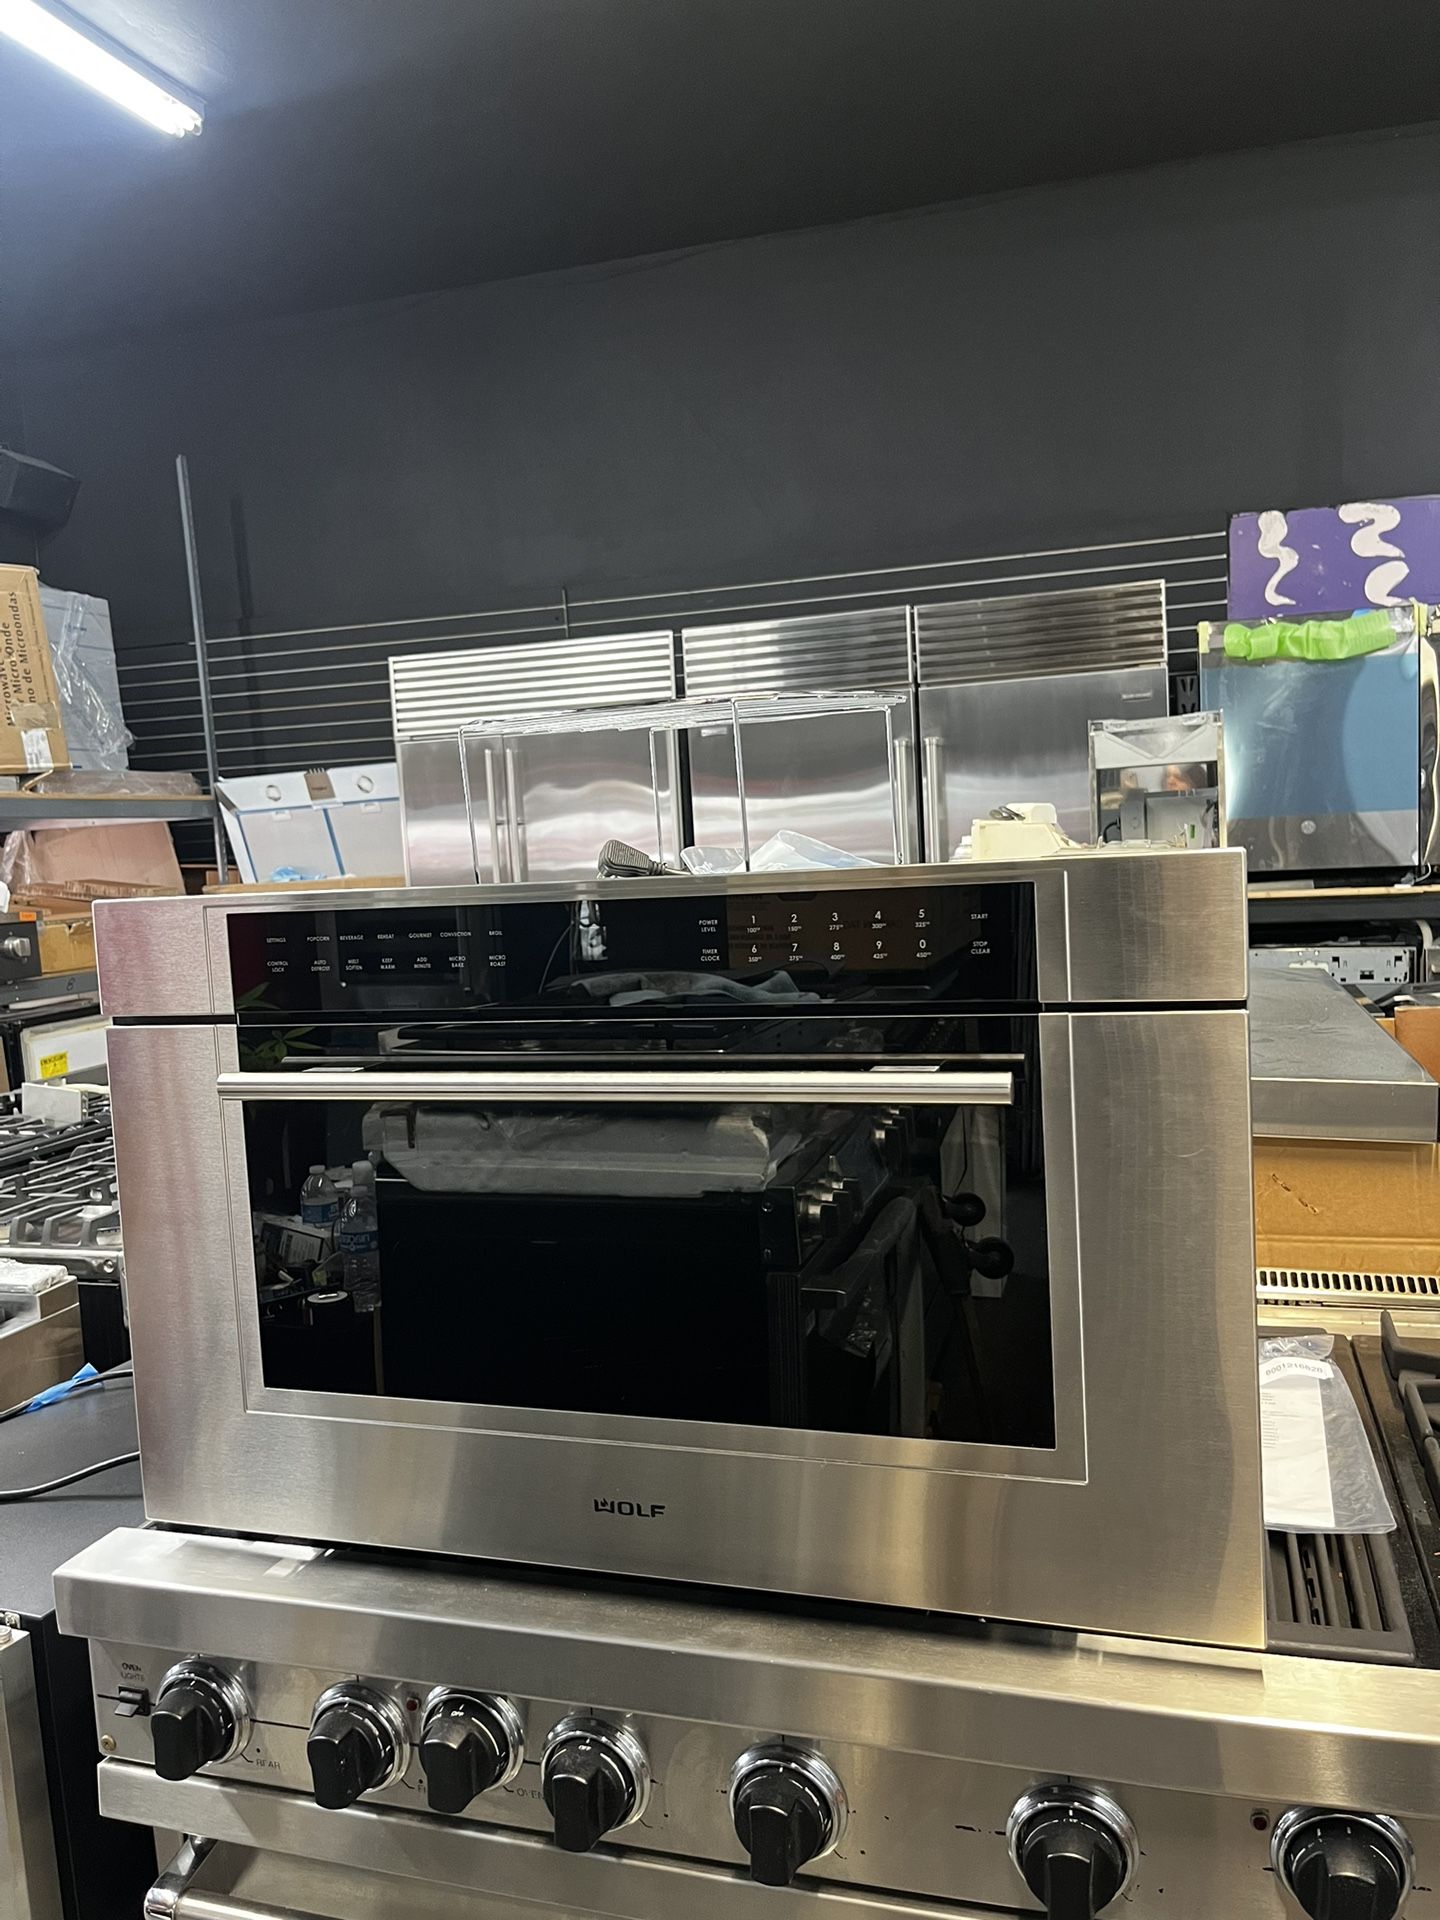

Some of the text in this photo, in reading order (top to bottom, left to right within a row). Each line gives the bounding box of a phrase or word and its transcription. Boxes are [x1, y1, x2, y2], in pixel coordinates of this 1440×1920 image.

[9, 591, 29, 664] Microondas
[10, 659, 22, 694] Micro
[22, 667, 33, 684] de
[791, 913, 798, 923] 2
[832, 912, 838, 921] 3
[875, 910, 882, 920] 4
[918, 908, 925, 918] 5
[751, 915, 756, 924] 1
[751, 944, 757, 953] 6
[792, 943, 798, 952] 7
[833, 942, 840, 951] 8
[876, 940, 882, 950] 9
[919, 939, 926, 949] 0
[593, 1497, 666, 1518] WOLF
